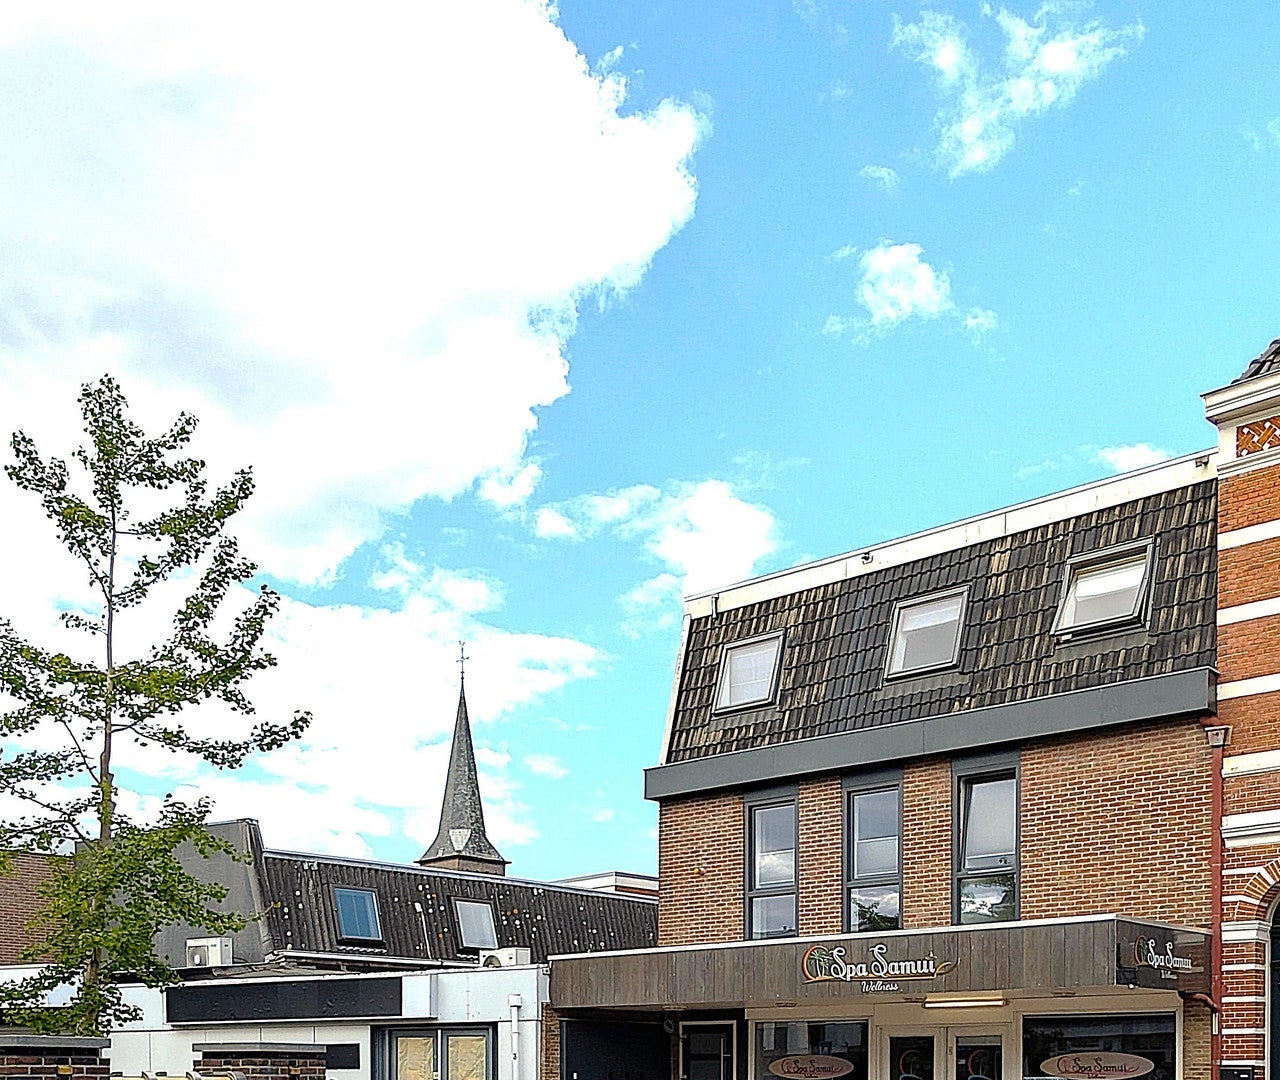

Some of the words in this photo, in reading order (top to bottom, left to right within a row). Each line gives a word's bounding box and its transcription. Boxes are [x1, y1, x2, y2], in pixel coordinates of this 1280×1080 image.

[828, 947, 868, 981] Spa
[869, 944, 935, 978] Samui
[1147, 939, 1165, 968] Spa
[861, 981, 899, 992] Wellness
